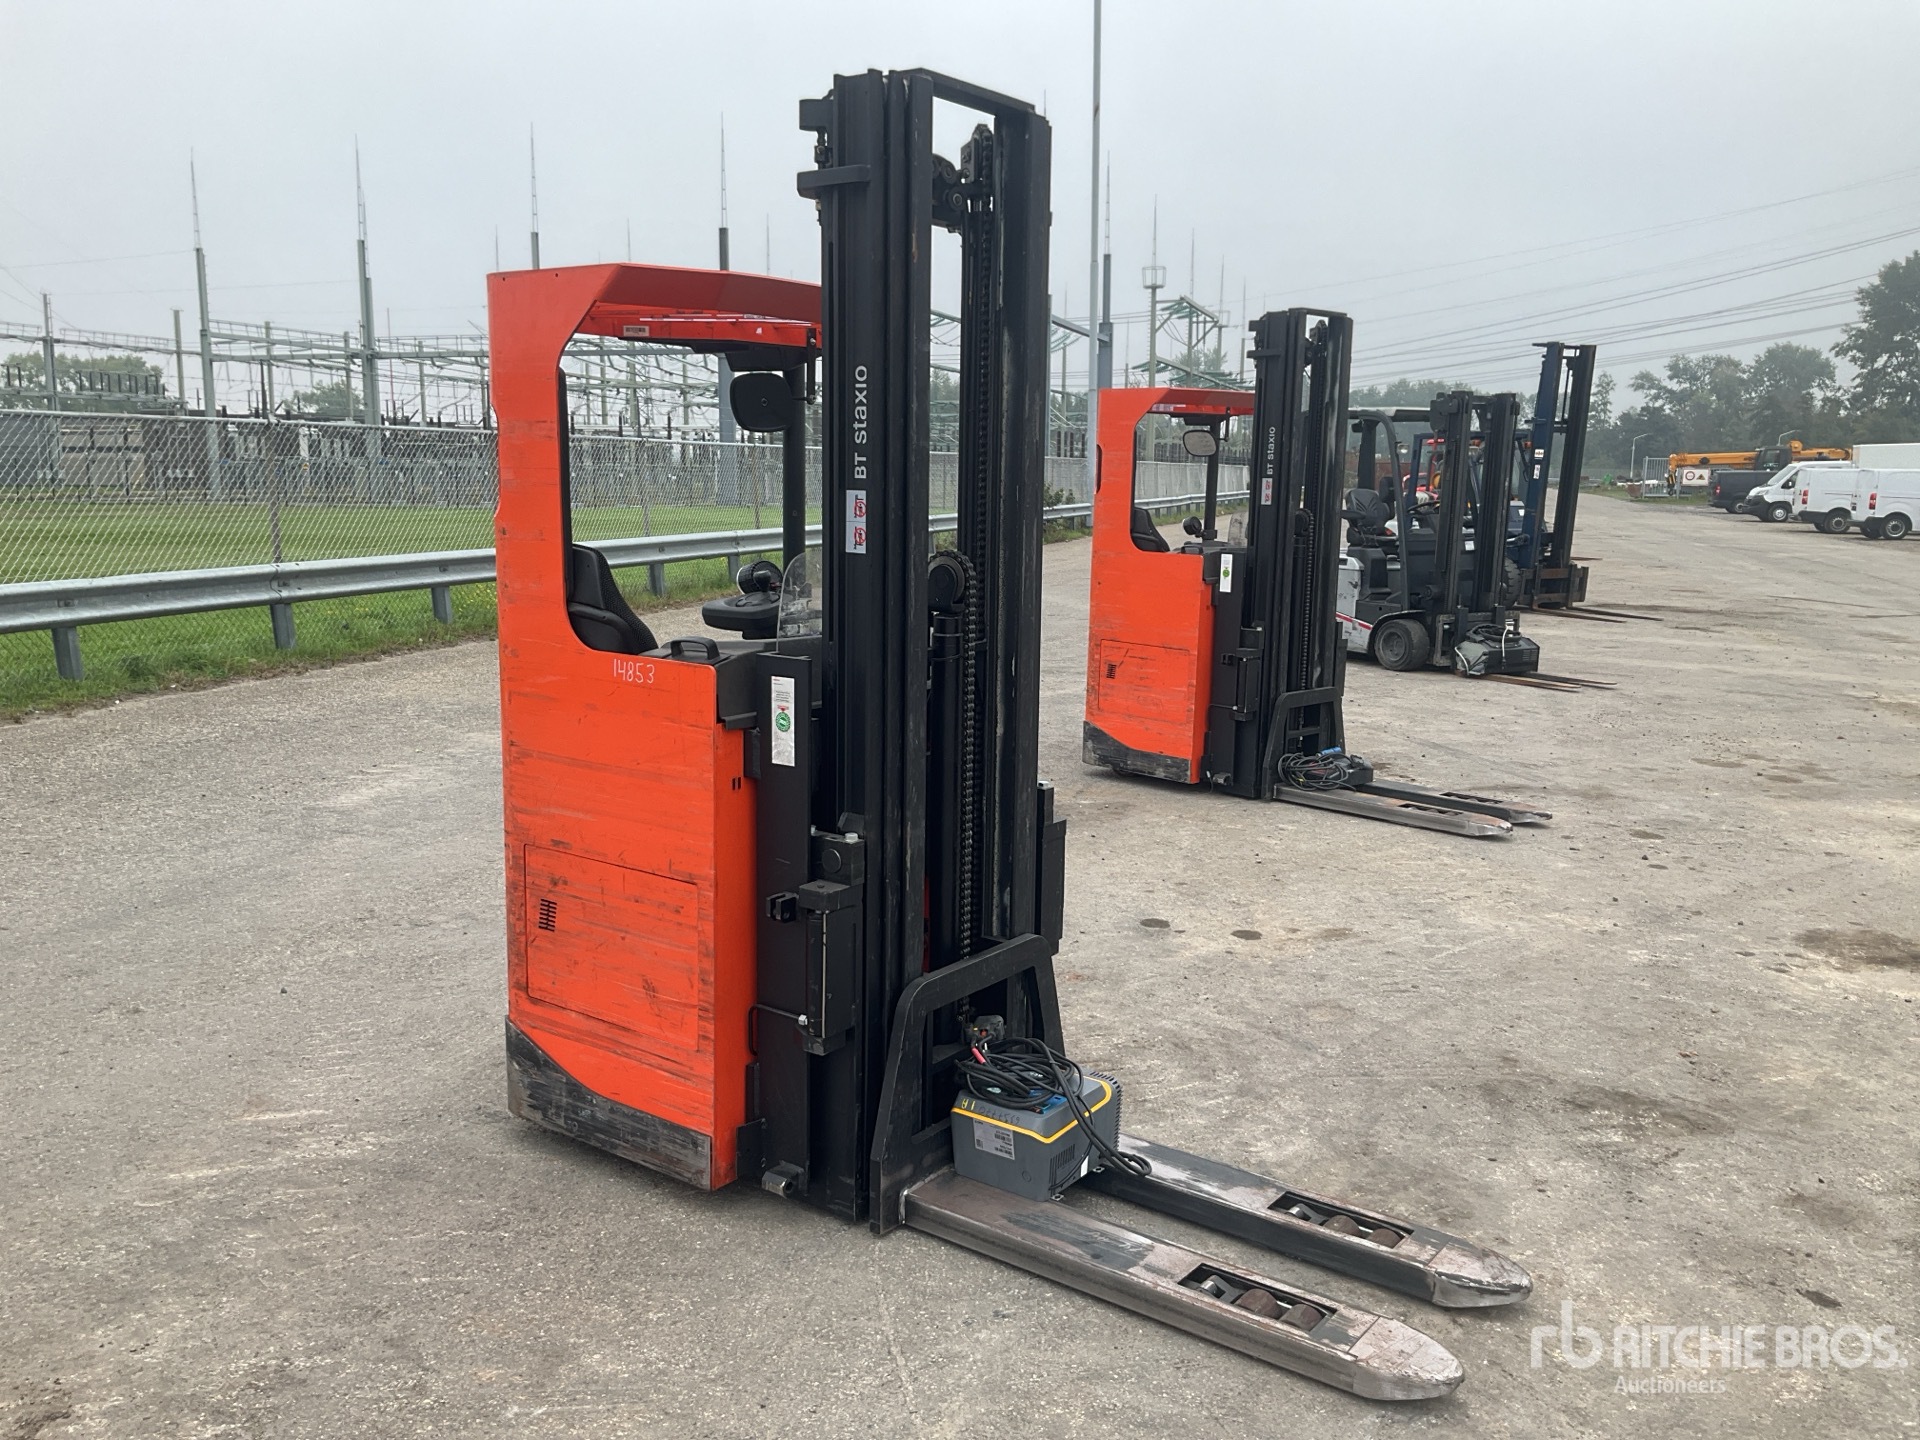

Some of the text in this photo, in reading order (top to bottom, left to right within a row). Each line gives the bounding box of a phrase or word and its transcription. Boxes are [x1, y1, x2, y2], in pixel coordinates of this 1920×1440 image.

[854, 452, 867, 479] BT
[1267, 462, 1274, 475] BT
[613, 658, 655, 684] 14853
